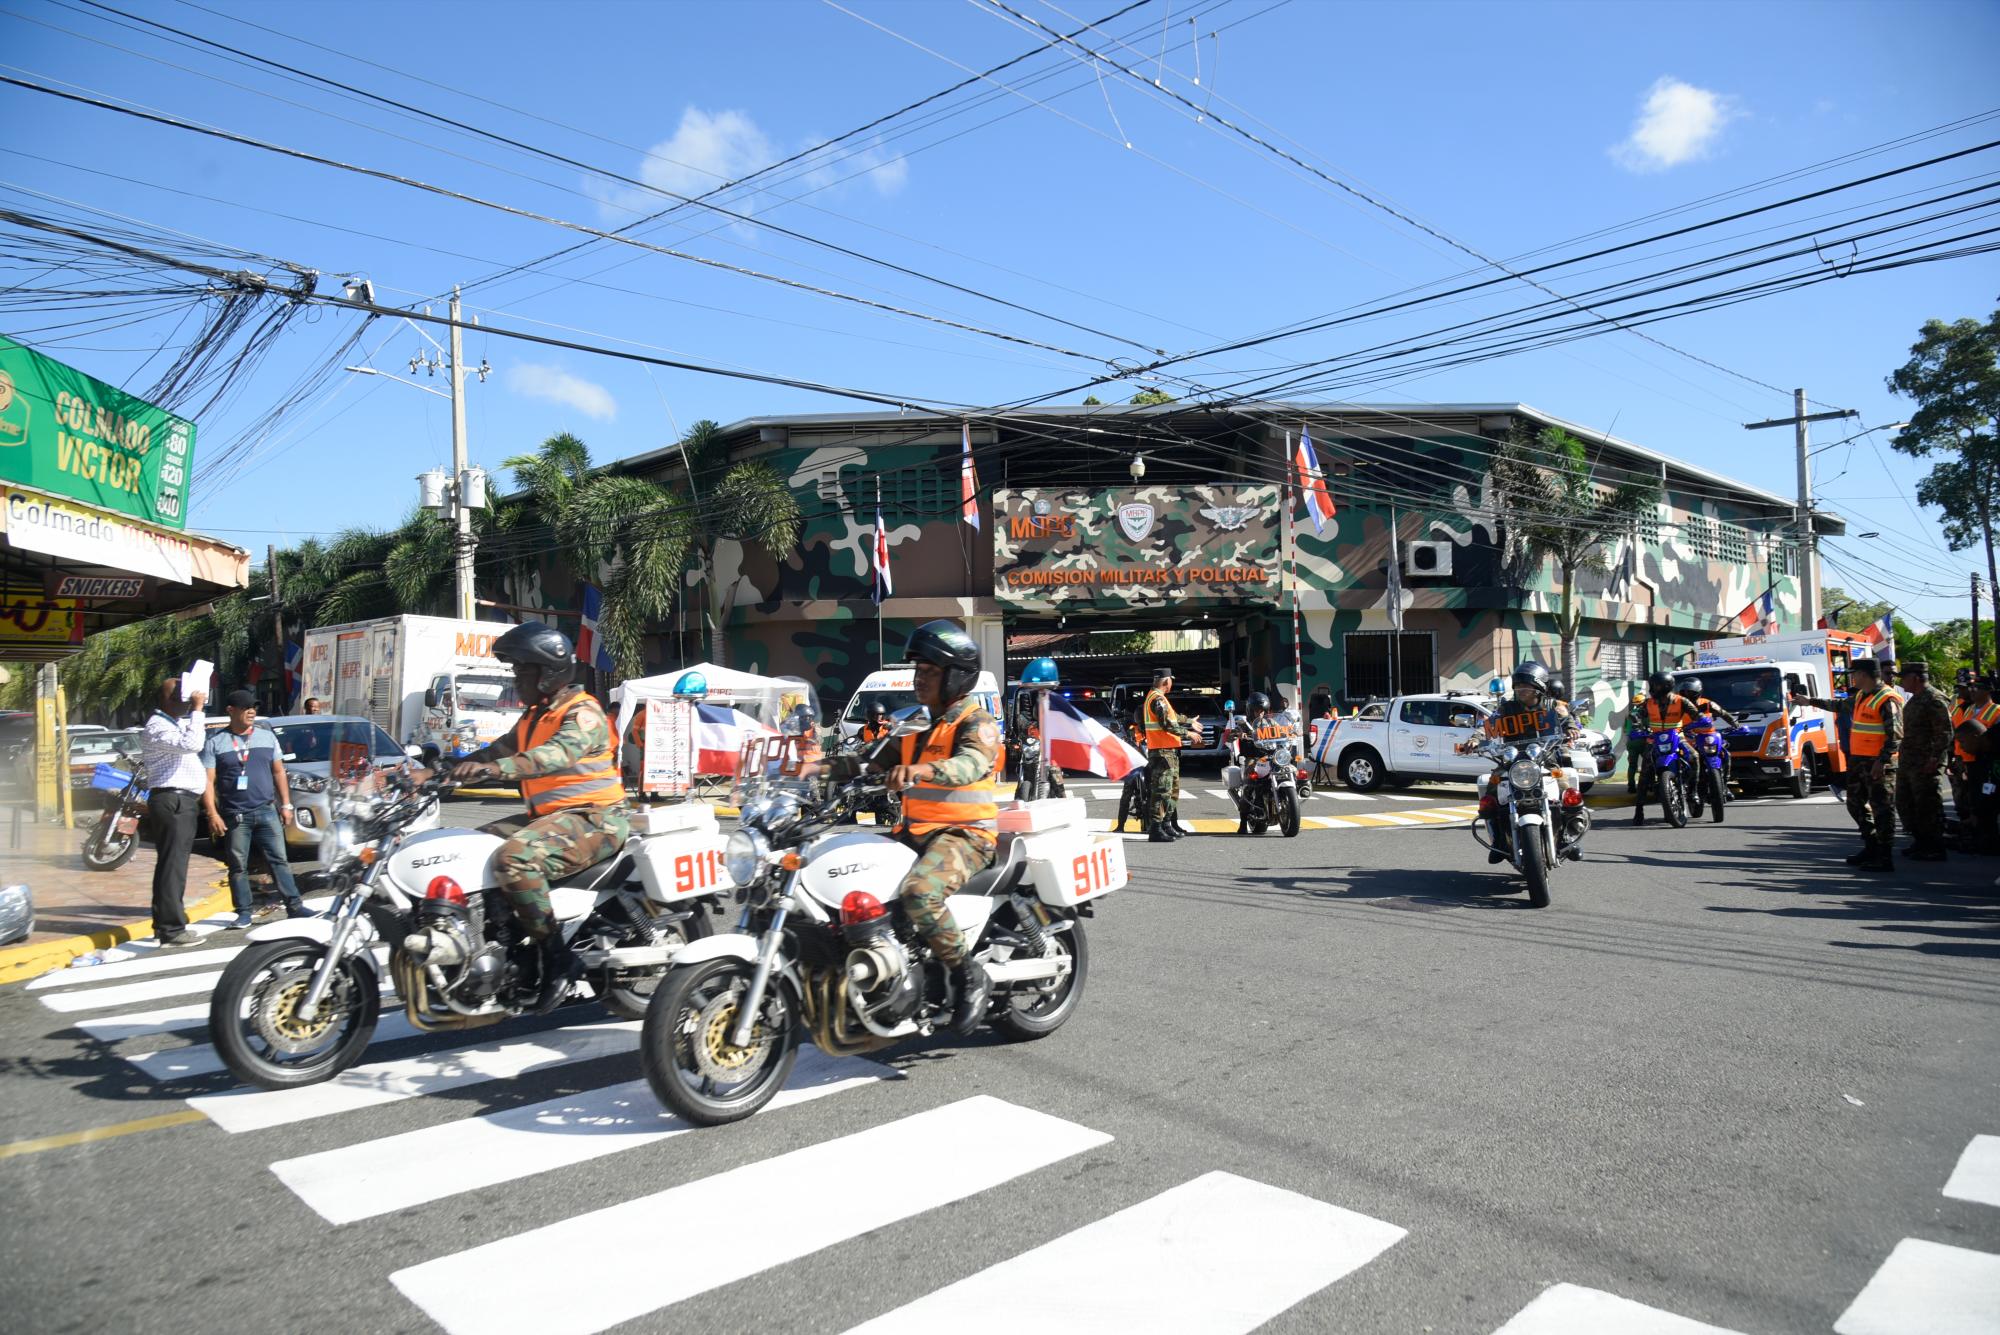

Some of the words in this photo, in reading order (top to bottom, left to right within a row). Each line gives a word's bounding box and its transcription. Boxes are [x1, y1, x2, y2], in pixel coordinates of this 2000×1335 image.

[55, 391, 151, 456] COLMADO
[57, 431, 142, 495] VICTOR
[8, 493, 114, 542] Colmado
[61, 578, 140, 597] SNICKERS
[1007, 570, 1095, 586] COMISION
[1100, 569, 1168, 585] MILITAR
[1173, 568, 1185, 583] Y
[1189, 566, 1270, 583] POLICIAL
[1699, 640, 1714, 650] 911
[1743, 635, 1767, 646] MOPC
[1256, 725, 1297, 740] MOPC
[1484, 708, 1550, 740] MOPC
[675, 850, 717, 893] 911
[1072, 848, 1110, 897] 911
